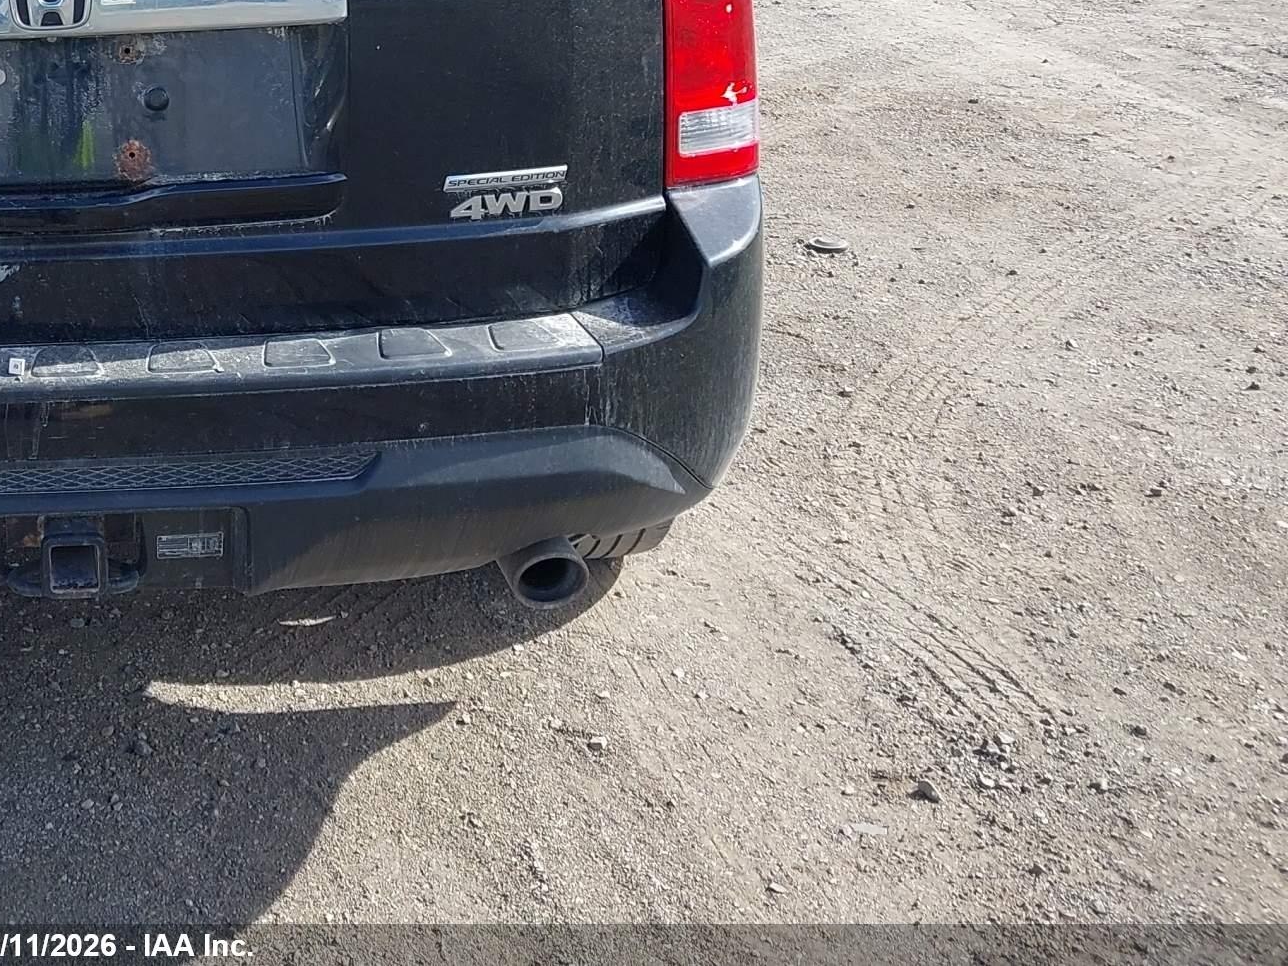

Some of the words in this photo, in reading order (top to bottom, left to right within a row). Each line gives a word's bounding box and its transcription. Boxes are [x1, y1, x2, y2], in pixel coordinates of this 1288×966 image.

[448, 176, 508, 187] SPECIAL
[511, 169, 566, 182] EDITION
[450, 186, 563, 220] 4WD
